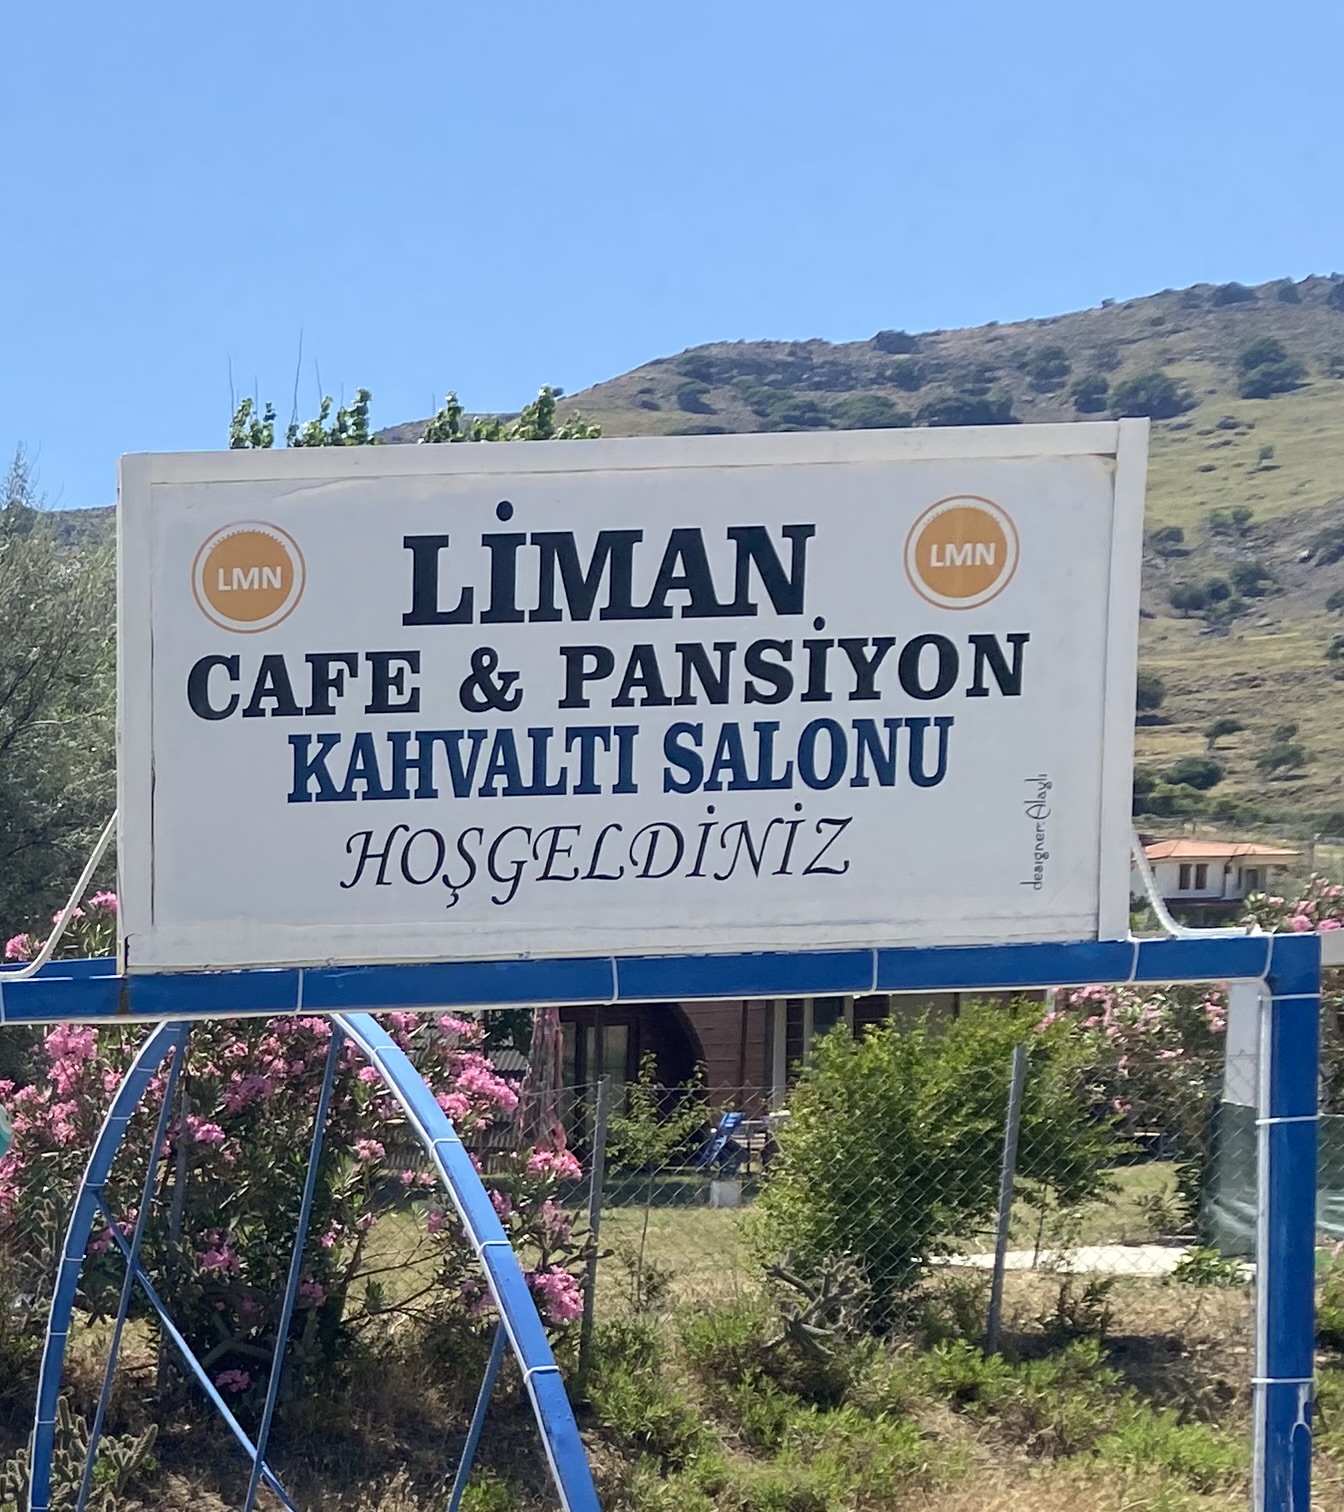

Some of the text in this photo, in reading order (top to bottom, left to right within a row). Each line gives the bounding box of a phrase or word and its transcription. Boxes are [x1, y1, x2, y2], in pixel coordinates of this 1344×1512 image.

[218, 566, 282, 591] LMN
[401, 500, 816, 627] LİMAN
[930, 542, 996, 567] LMN
[187, 616, 1031, 721] CAFE & PANSİYON
[287, 716, 956, 804] KAHVALTI SALONU
[339, 802, 853, 909] HOŞGELDİNİZ
